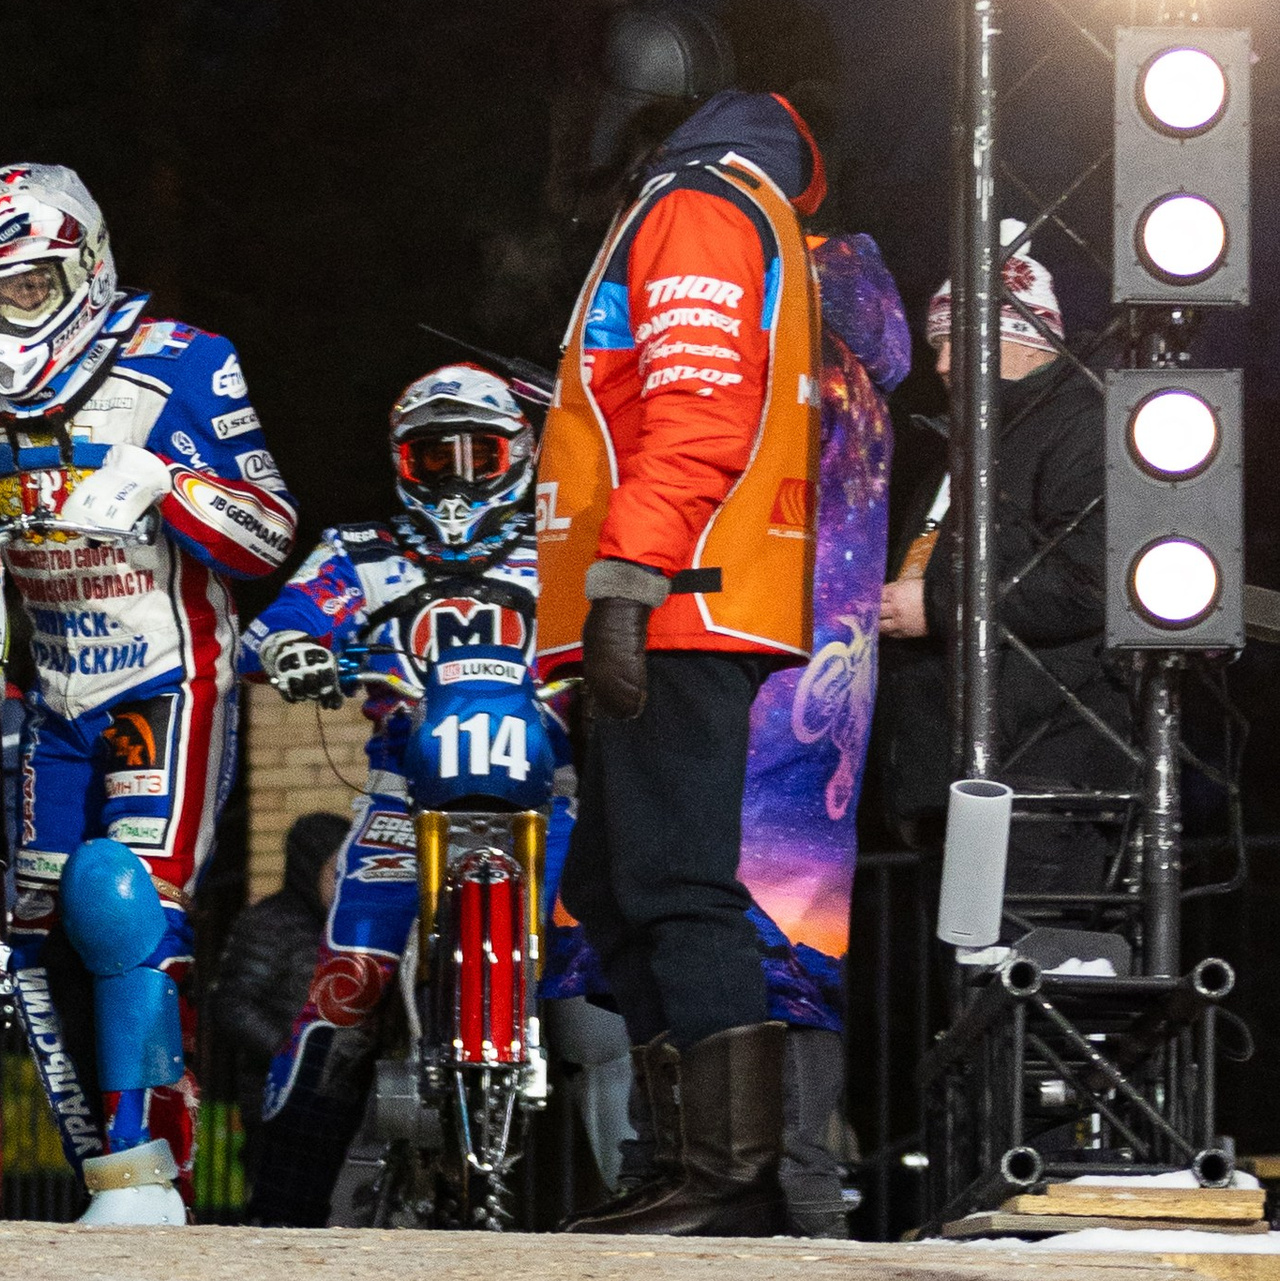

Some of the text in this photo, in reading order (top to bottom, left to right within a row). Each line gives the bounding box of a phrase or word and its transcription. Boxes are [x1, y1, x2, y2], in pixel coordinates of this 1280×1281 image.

[645, 275, 744, 308] THOR
[651, 307, 741, 337] MOTOREX
[226, 503, 280, 547] GERMAN
[82, 570, 155, 600] ОБЛАСТИ
[462, 662, 519, 680] LUKOIL
[431, 713, 531, 781] 114
